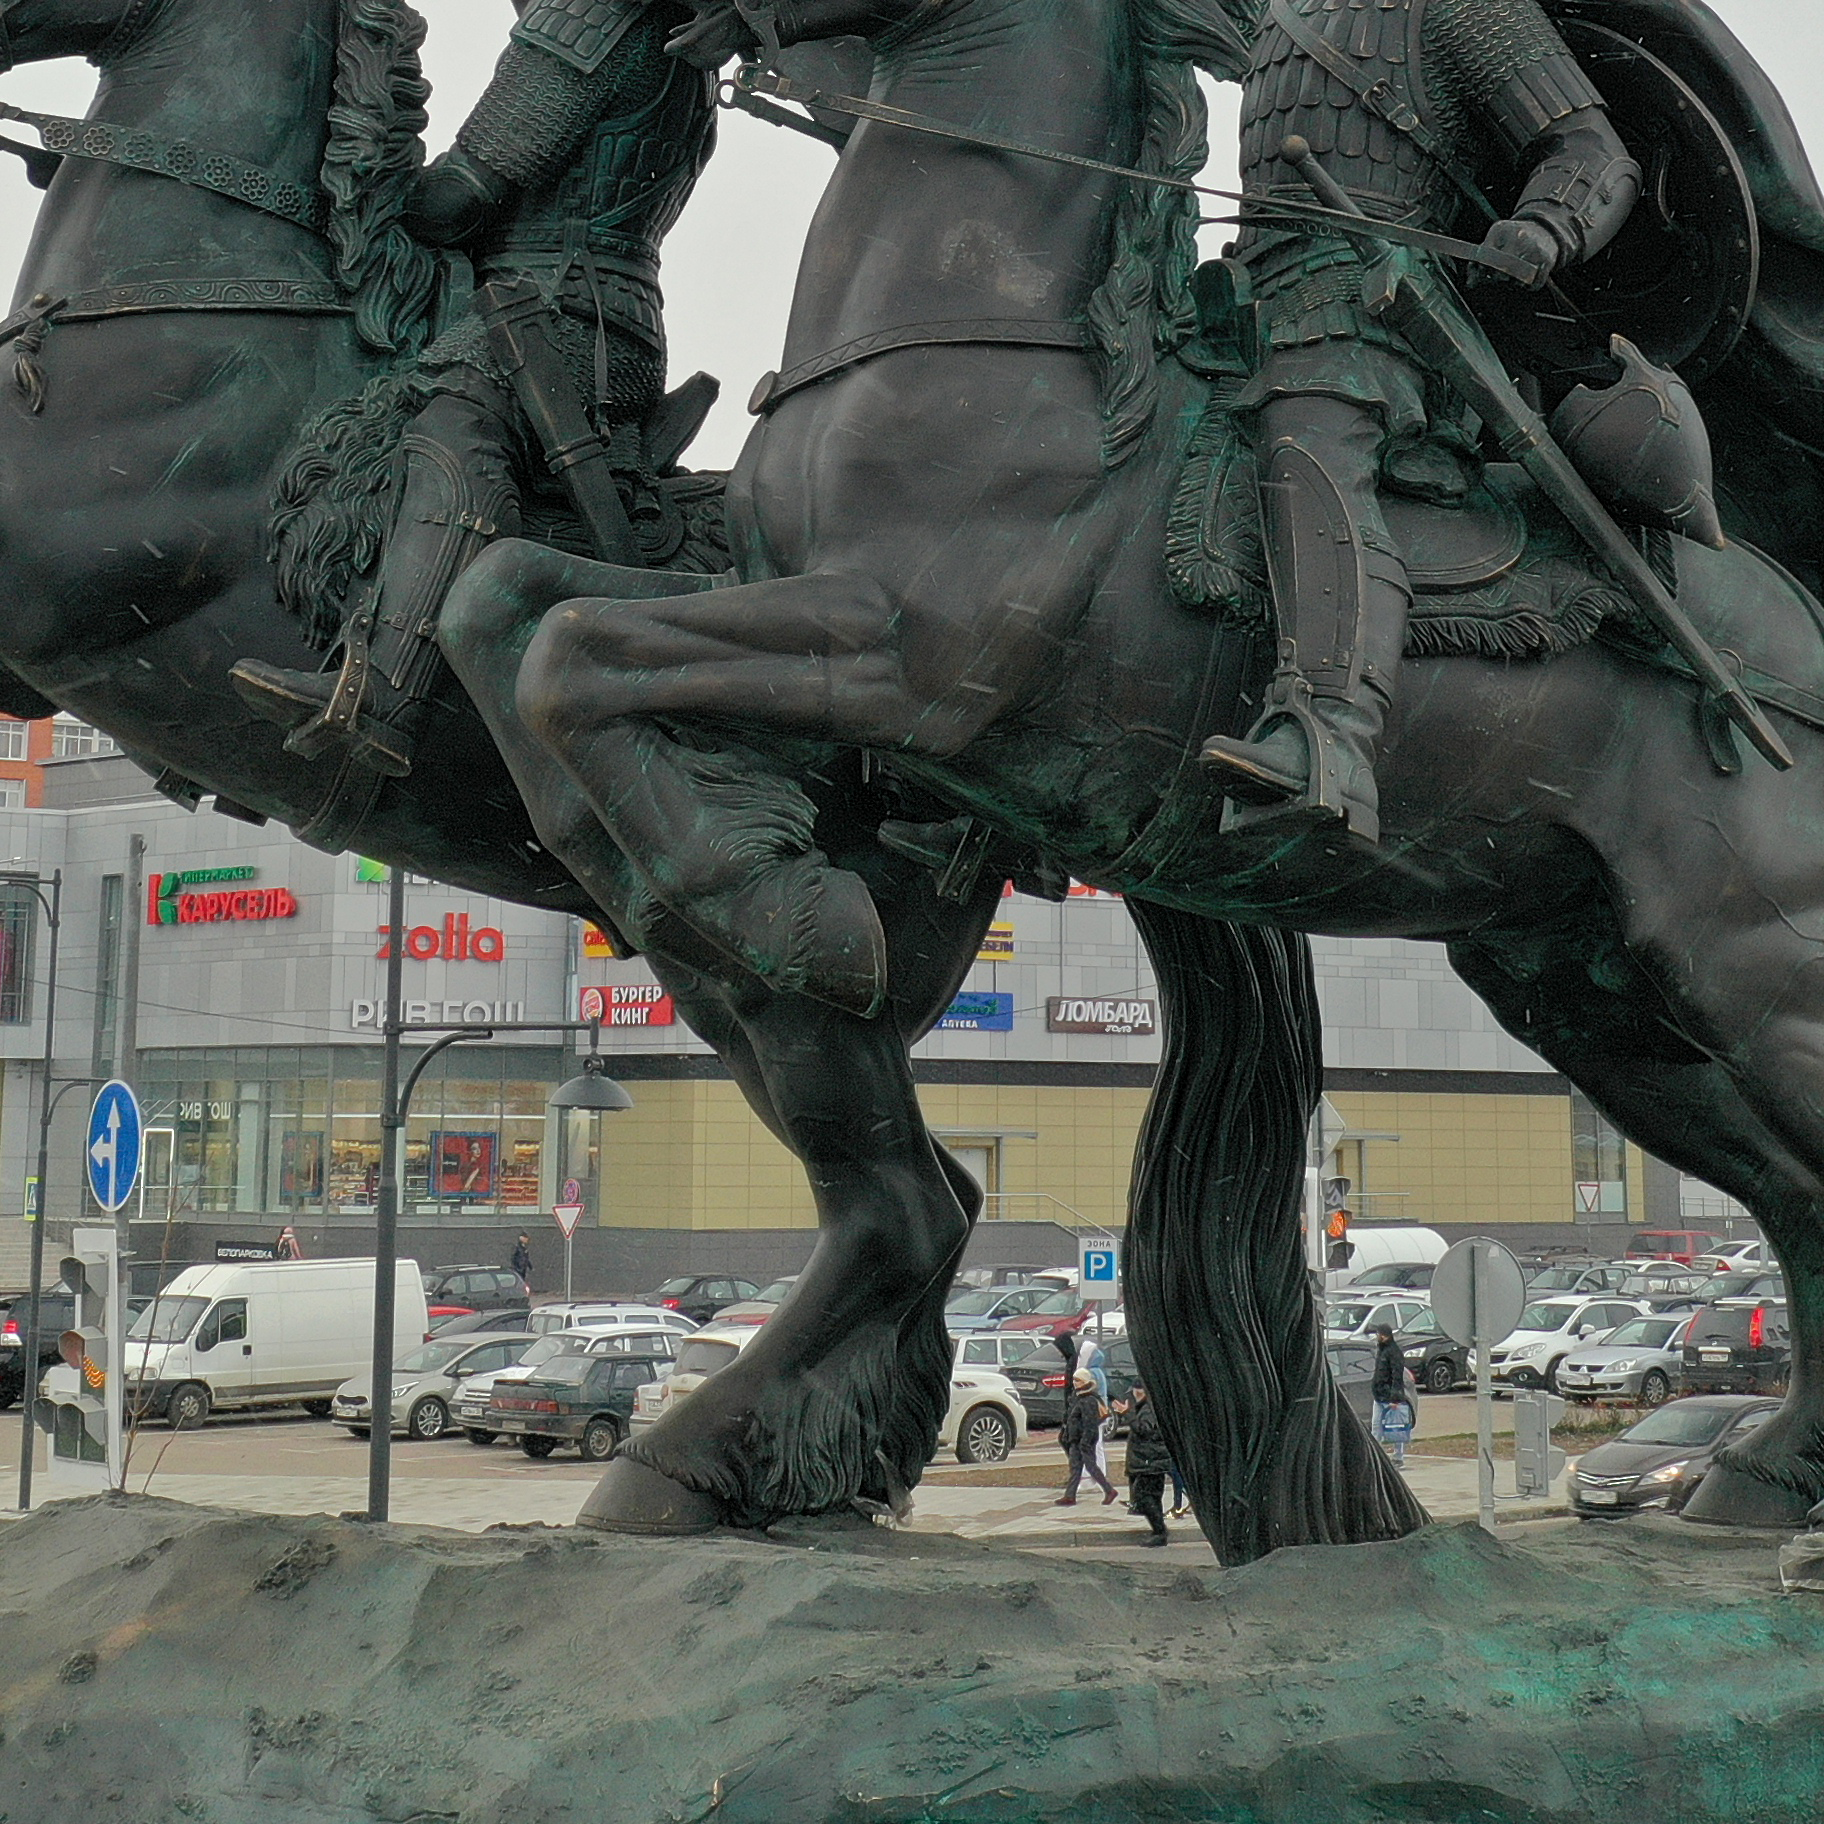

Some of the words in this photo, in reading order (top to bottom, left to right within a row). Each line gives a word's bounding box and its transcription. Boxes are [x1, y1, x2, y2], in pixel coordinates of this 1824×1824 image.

[179, 888, 297, 923] КАРУСЕЛЬ
[611, 987, 663, 1004] БУРГЕР
[611, 1008, 650, 1025] КИНГ
[1055, 1000, 1152, 1028] ЛОМБАРД
[941, 1020, 978, 1028] АПТЕКА
[1087, 1240, 1111, 1248] ЗОНА
